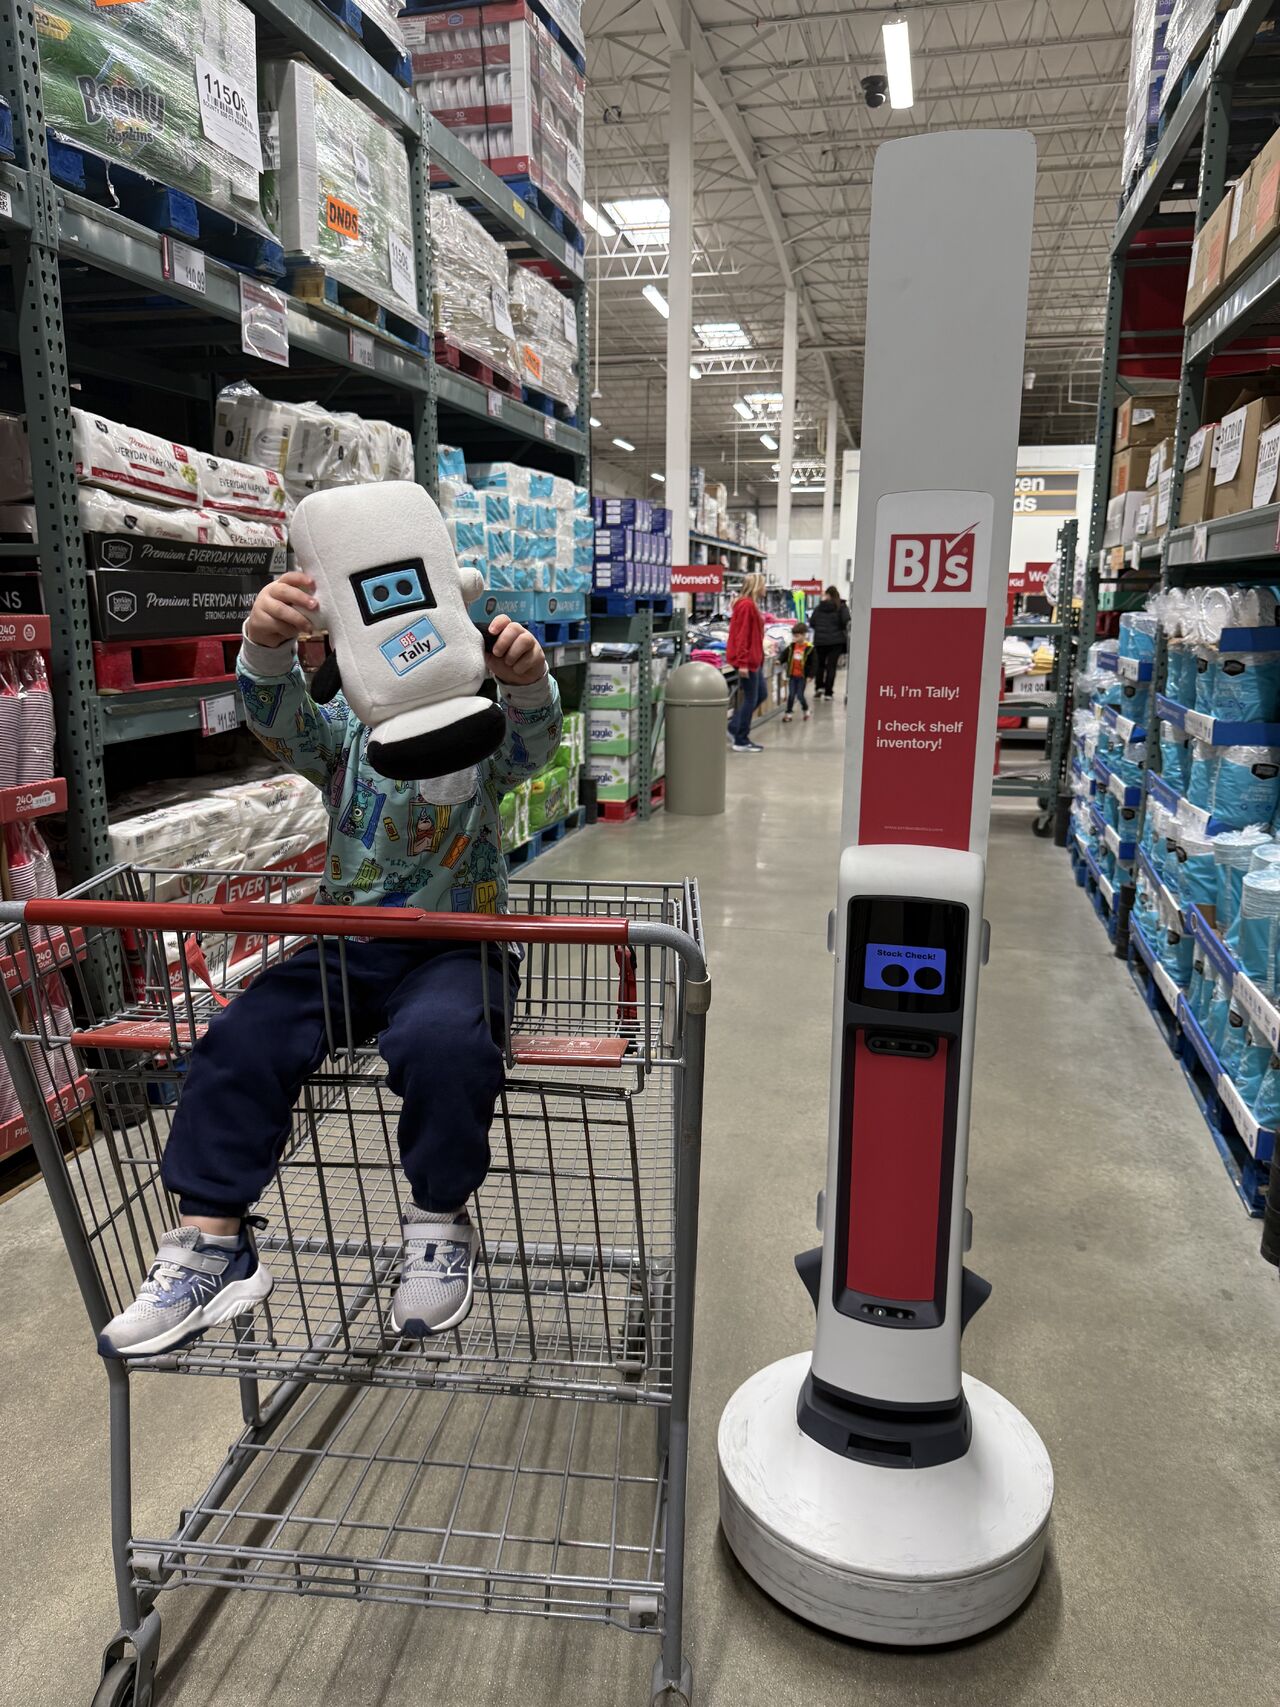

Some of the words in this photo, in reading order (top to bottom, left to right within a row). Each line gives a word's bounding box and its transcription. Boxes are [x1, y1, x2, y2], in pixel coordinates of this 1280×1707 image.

[329, 202, 358, 234] DNDS
[140, 543, 186, 562] Premium
[186, 549, 232, 564] EVERYDAY
[232, 550, 268, 565] NAPKINS
[671, 572, 720, 586] Women's
[146, 592, 190, 609] Premium
[192, 593, 238, 608] EVERYDAY
[239, 592, 257, 607] NAPK
[204, 611, 227, 621] STRONG
[226, 611, 238, 620] AND
[399, 640, 432, 663] Tally
[590, 682, 614, 694] uggle
[879, 685, 897, 699] Hi,
[901, 686, 922, 698] I'm
[925, 686, 960, 701] Tally!
[877, 719, 882, 731] I
[885, 720, 926, 732] check
[929, 721, 964, 733] shelf
[876, 737, 942, 751] inventory!
[16, 793, 33, 806] 240
[876, 948, 903, 958] Stock
[905, 951, 936, 961] Check!
